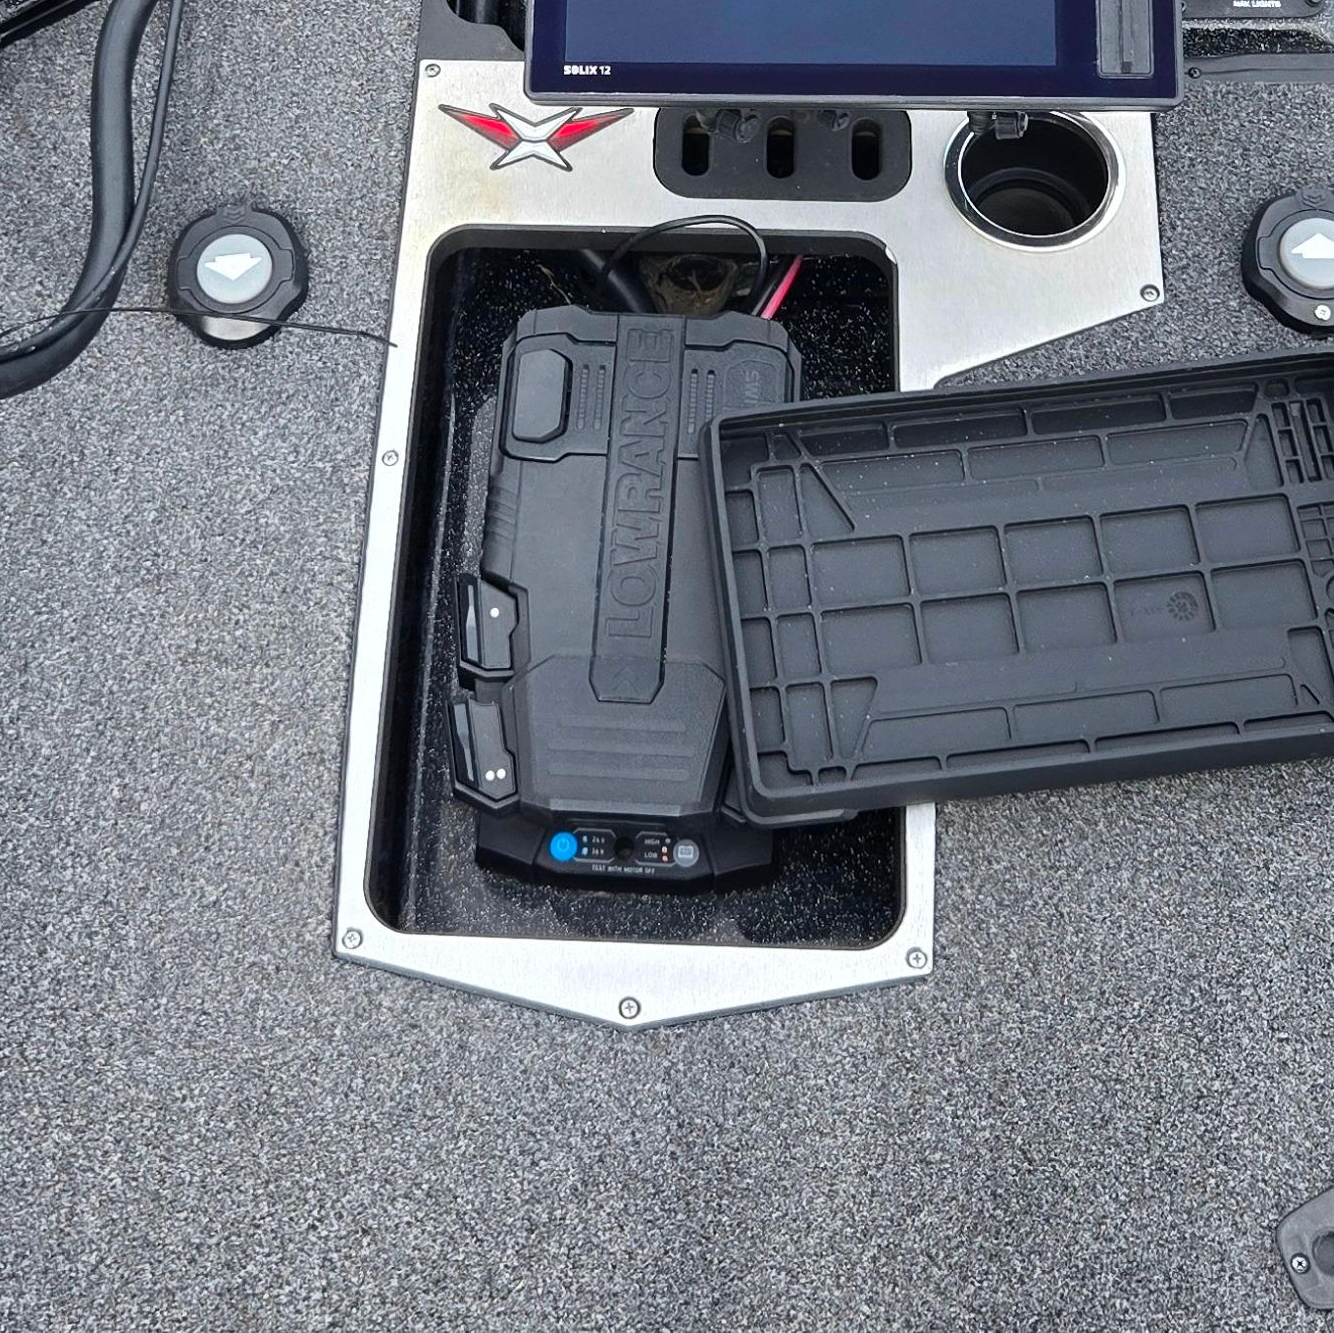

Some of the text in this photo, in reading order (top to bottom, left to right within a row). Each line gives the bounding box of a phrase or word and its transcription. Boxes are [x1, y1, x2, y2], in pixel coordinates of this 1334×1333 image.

[563, 64, 612, 76] SOLIX 12
[604, 326, 675, 640] LOWRANCE
